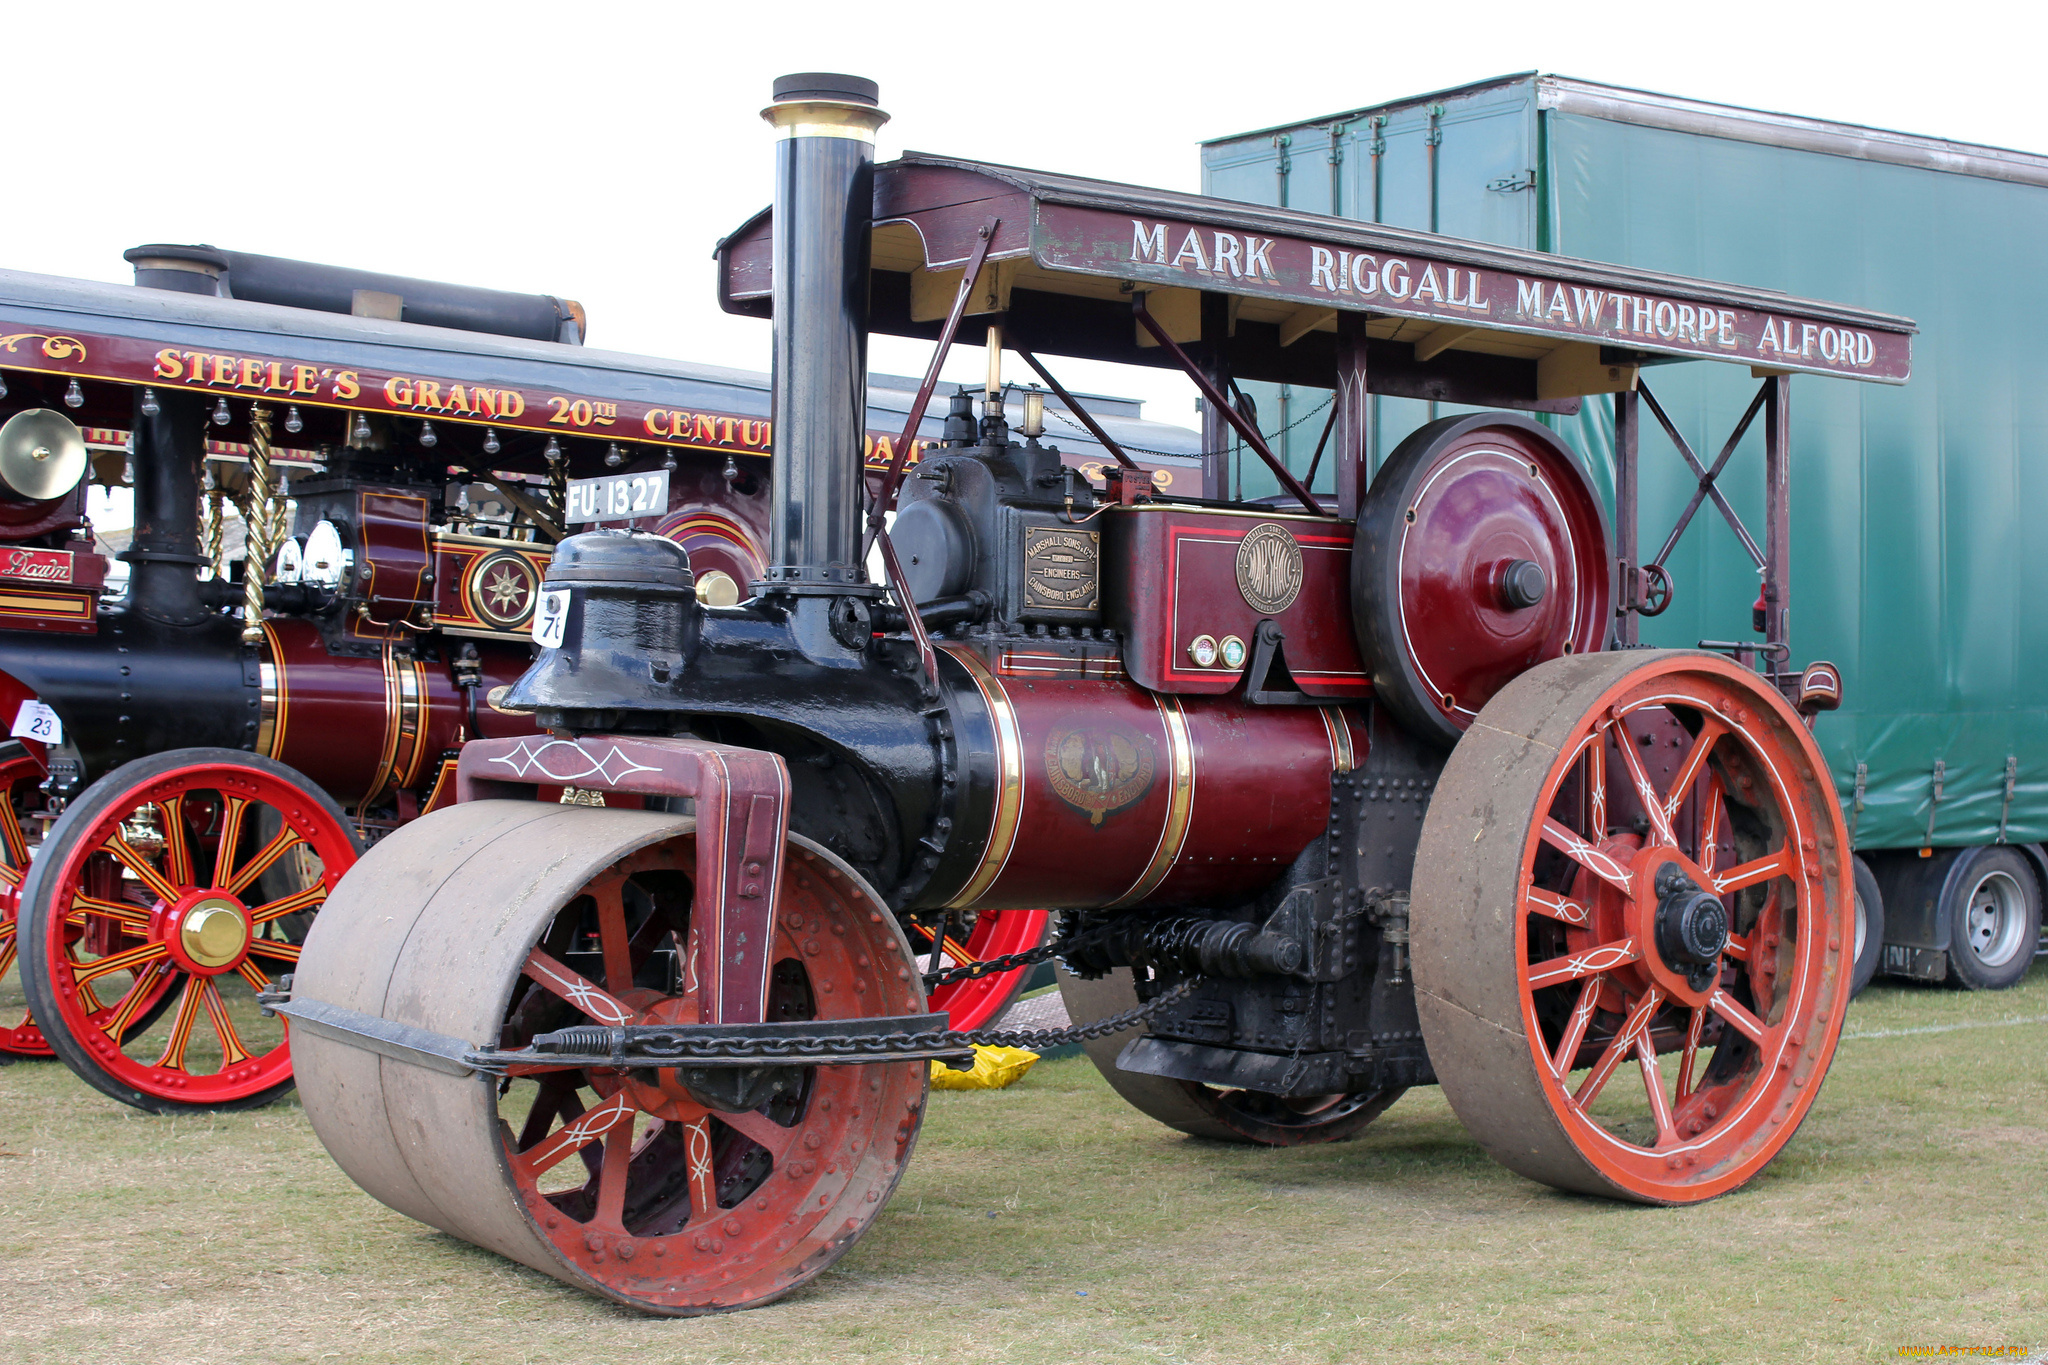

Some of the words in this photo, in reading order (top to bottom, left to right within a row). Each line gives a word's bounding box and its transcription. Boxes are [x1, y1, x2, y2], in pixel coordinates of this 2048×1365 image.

[1129, 219, 1279, 284] MARK
[1309, 245, 1491, 312] RIGGALL
[1515, 278, 1738, 347] MAWTHORPE
[1756, 315, 1875, 367] ALFORD
[154, 348, 361, 400] STEELE'S
[383, 376, 526, 420] GRAND
[643, 408, 772, 449] CENTU
[567, 483, 596, 518] FU
[607, 476, 663, 515] 1327
[1027, 536, 1062, 559] MARSHALL
[1063, 537, 1082, 551] SONS
[2, 550, 70, 579] Dawn
[1044, 567, 1080, 580] ENGINEERS
[30, 717, 52, 736] 23
